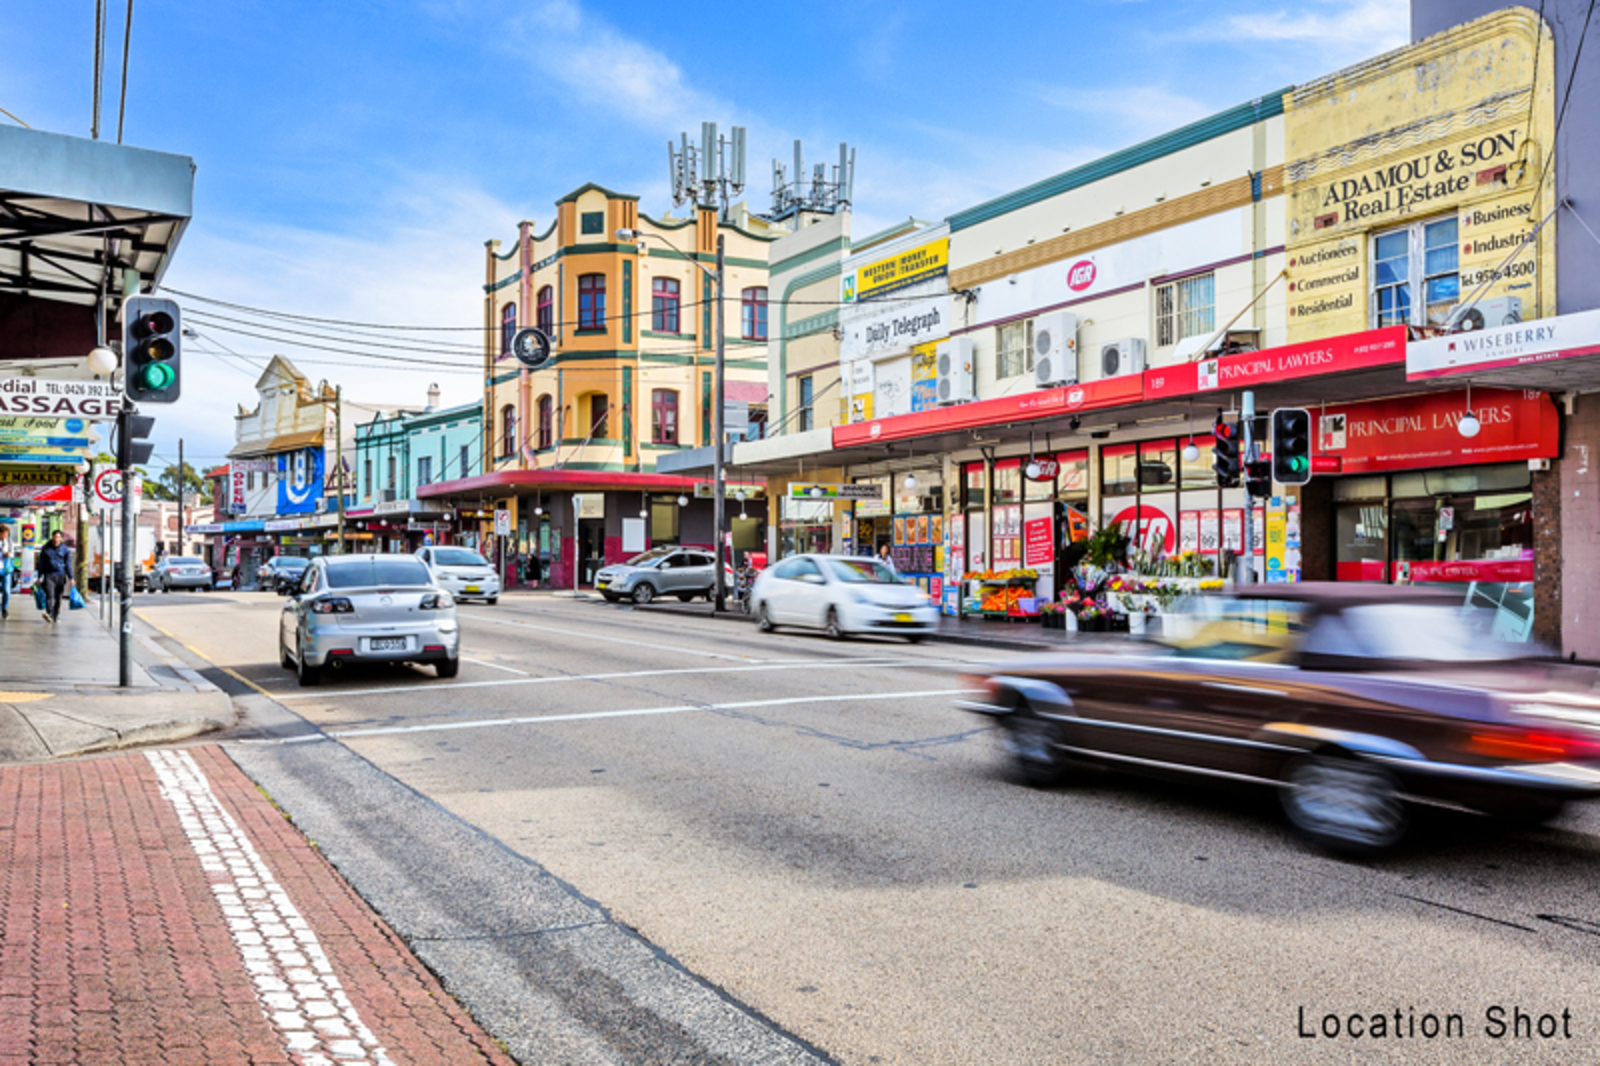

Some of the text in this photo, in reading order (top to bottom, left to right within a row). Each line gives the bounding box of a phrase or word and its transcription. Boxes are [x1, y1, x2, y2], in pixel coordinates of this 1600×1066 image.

[1323, 129, 1517, 207] ADAMOU & SON
[1343, 173, 1470, 222] Real Estate
[1472, 201, 1532, 226] Business
[1473, 227, 1536, 255] Industria
[864, 250, 926, 278] WESTERN MONEY
[873, 270, 895, 284] UNION
[901, 254, 939, 275] TRANSFER
[1297, 244, 1358, 267] Auctioneers
[1503, 260, 1536, 278] 4500
[1297, 267, 1359, 293] Commercial
[1297, 294, 1353, 317] Residential
[866, 307, 941, 344] Daily Telegraph
[1463, 325, 1557, 352] WISEBERRY
[1219, 359, 1275, 380] PRINCIPAL
[1278, 348, 1333, 375] LAWYERS
[0, 379, 37, 394] dial
[64, 383, 86, 396] 0426
[1350, 405, 1512, 438] PRINCIPAL LAWERS
[102, 479, 123, 495] 50
[233, 471, 245, 504] OPEN
